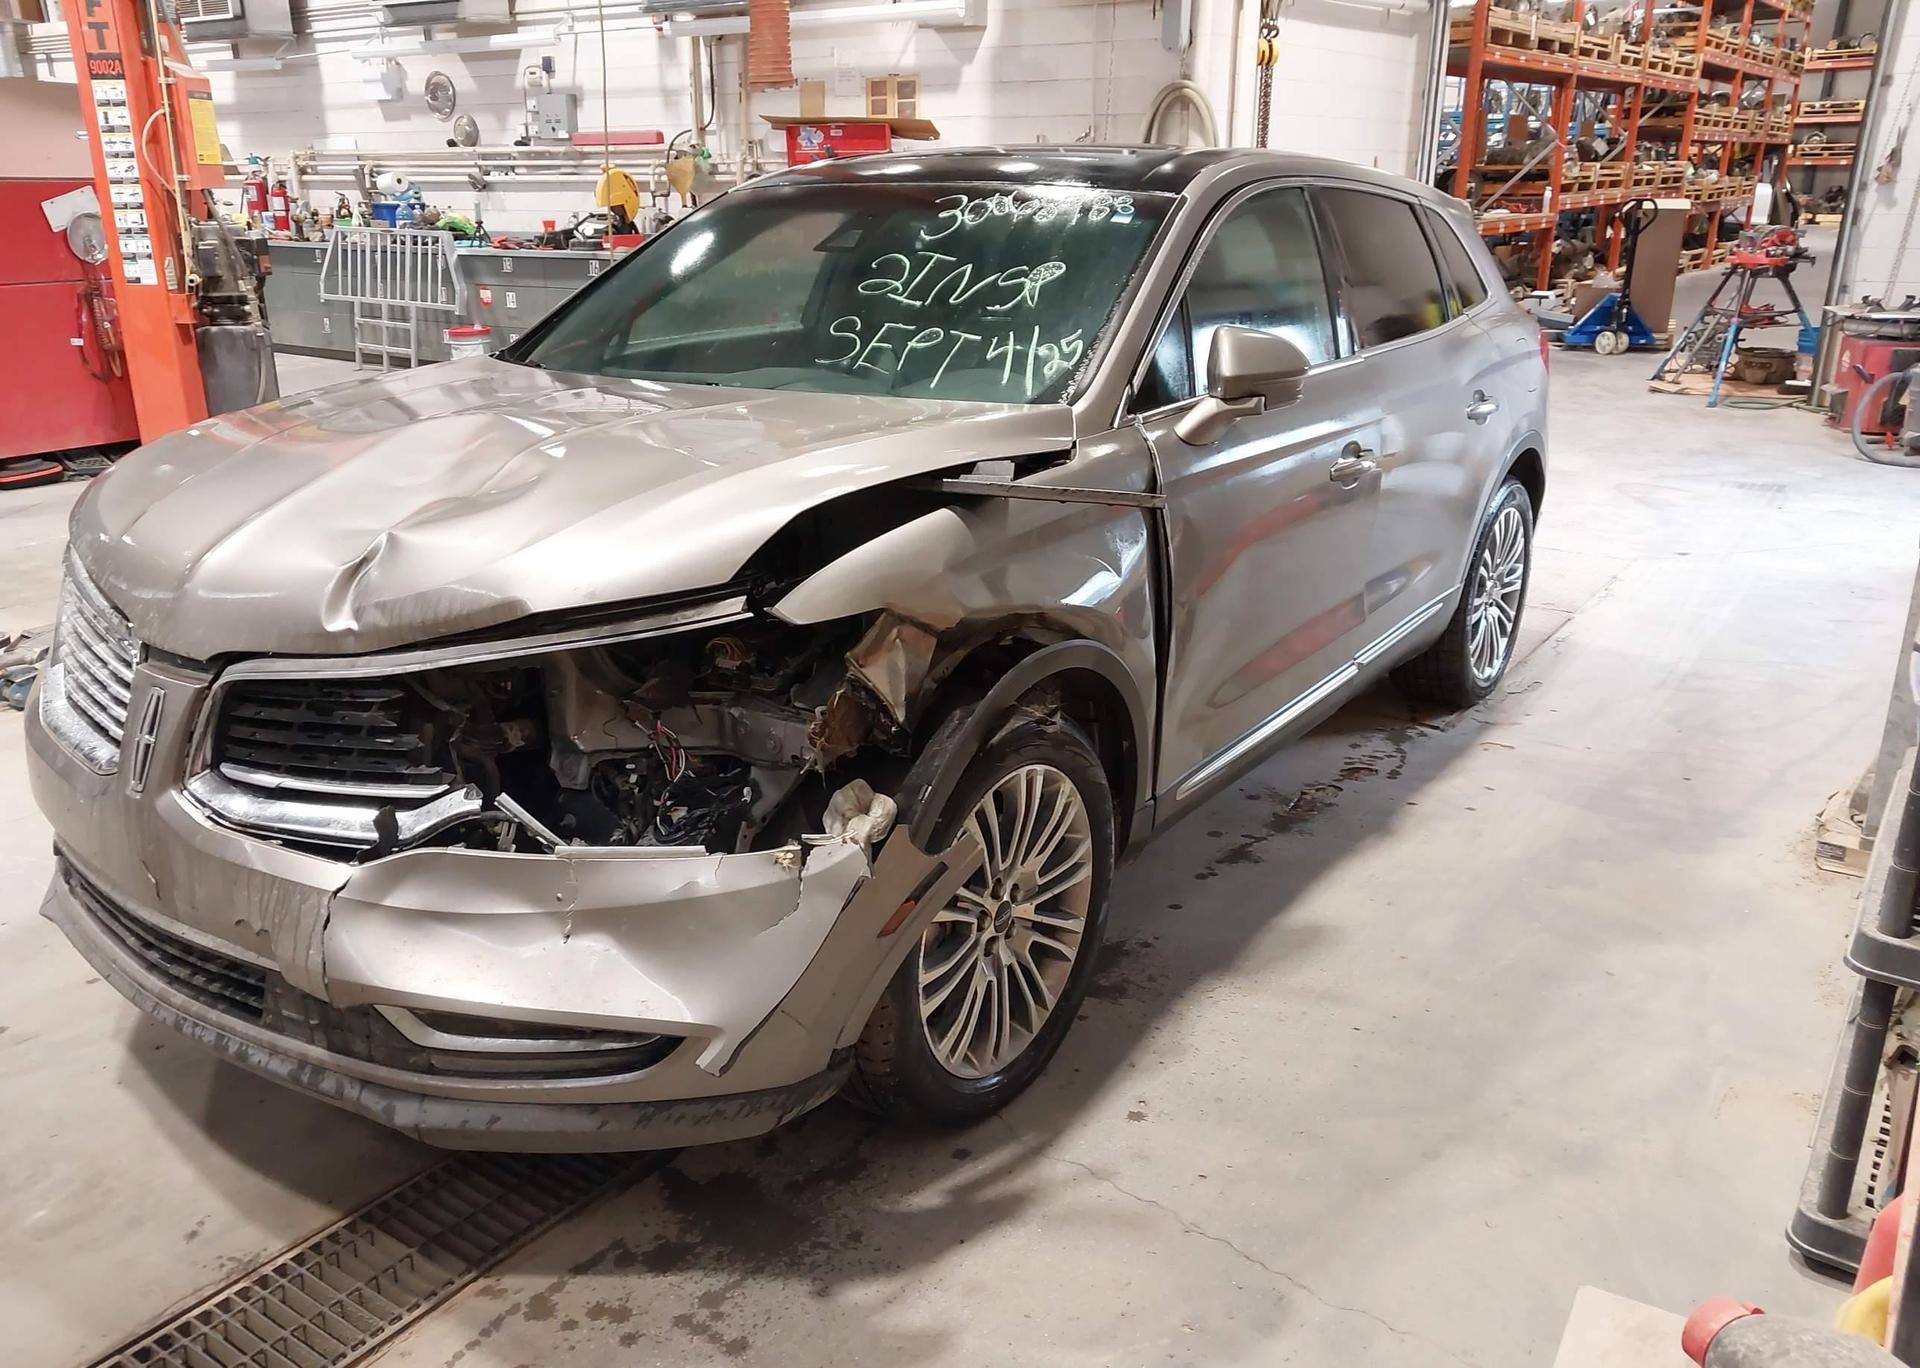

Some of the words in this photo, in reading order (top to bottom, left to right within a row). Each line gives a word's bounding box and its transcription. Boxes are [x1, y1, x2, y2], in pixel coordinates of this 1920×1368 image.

[89, 60, 122, 76] 9002A
[815, 316, 983, 389] SEPT
[986, 325, 1084, 397] 4/25
